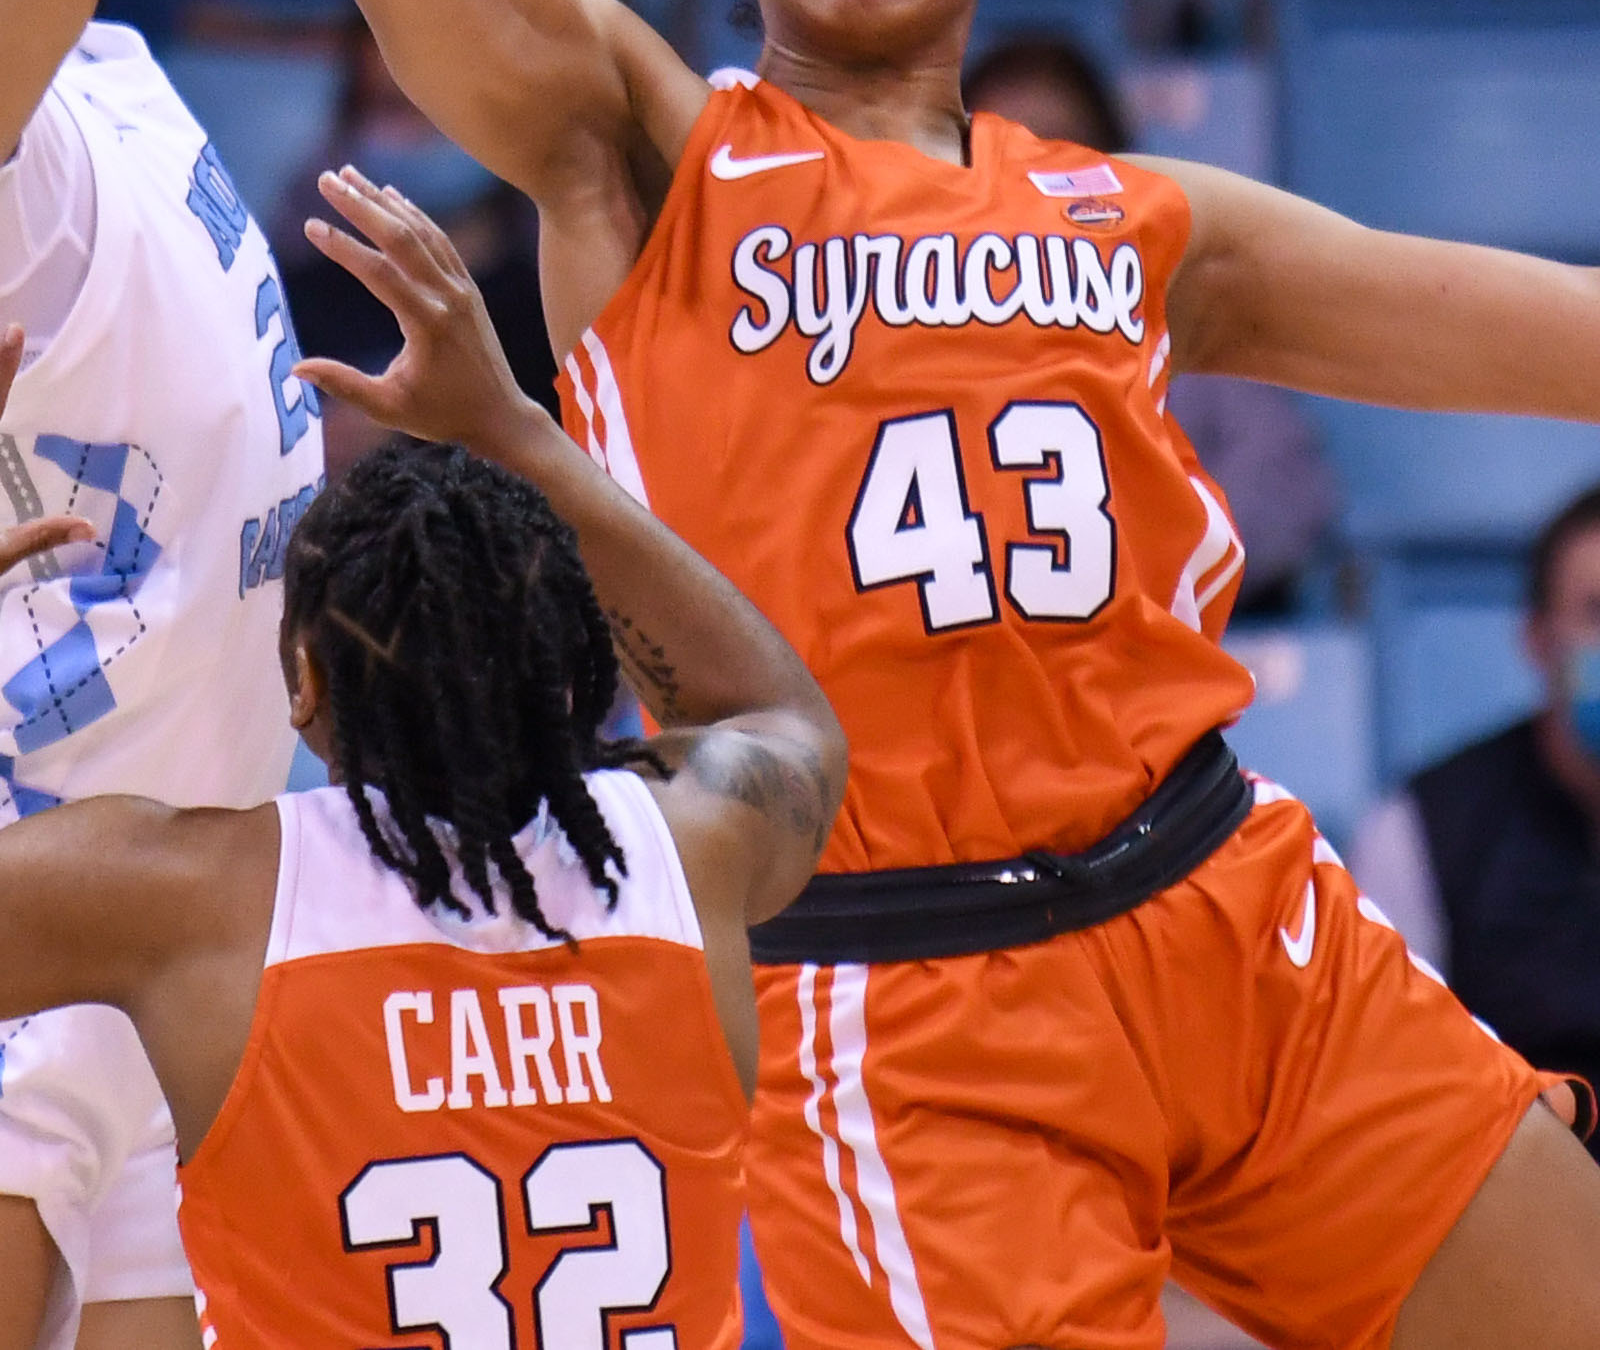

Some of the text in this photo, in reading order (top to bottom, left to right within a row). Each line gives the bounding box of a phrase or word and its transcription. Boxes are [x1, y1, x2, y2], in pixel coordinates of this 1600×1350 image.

[729, 224, 1145, 386] Syracuse
[844, 400, 1117, 636] 43
[382, 983, 613, 1114] CARR
[337, 1135, 677, 1350] 32
